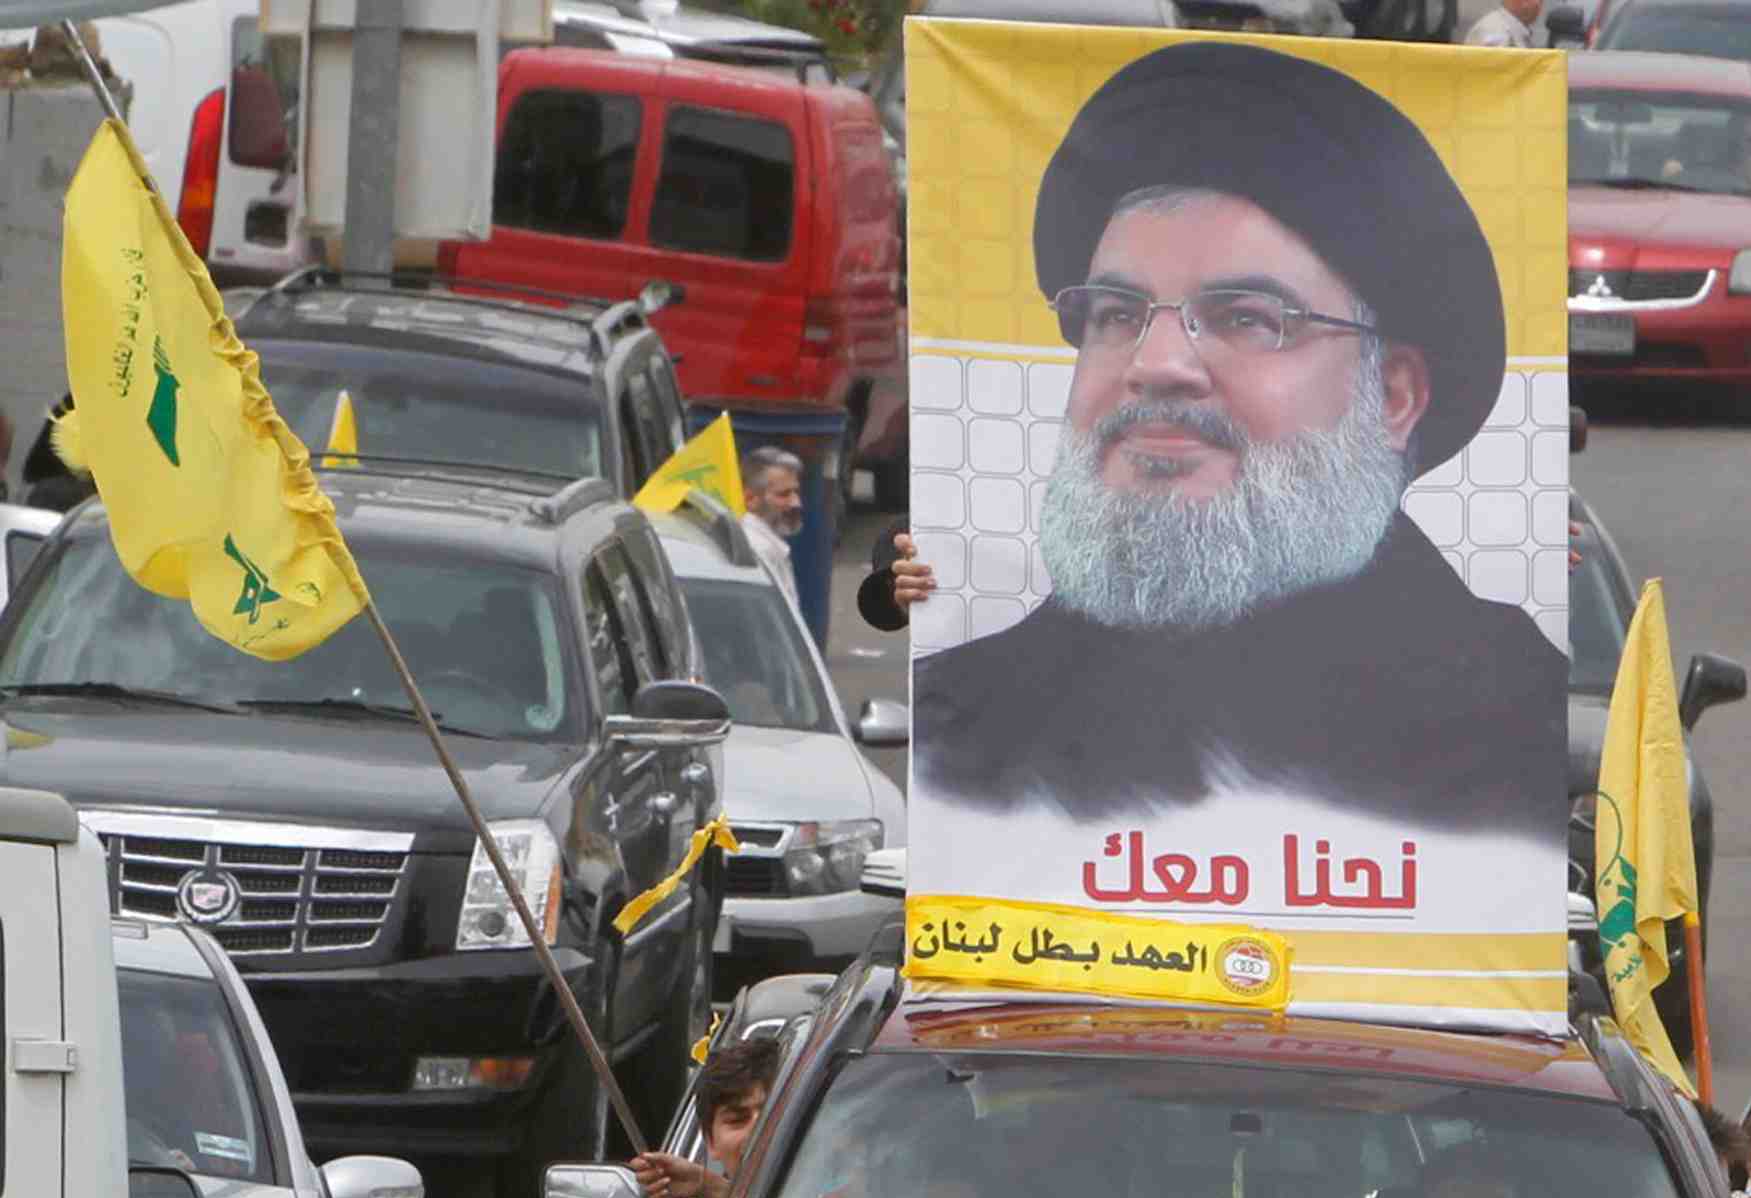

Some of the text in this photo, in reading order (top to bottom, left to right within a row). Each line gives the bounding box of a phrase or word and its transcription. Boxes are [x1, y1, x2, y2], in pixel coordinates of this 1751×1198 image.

[1083, 831, 1416, 909] نحنا معك
[912, 919, 1002, 963] لبنان
[1012, 925, 1100, 971] بطل
[1111, 941, 1207, 973] العهد
